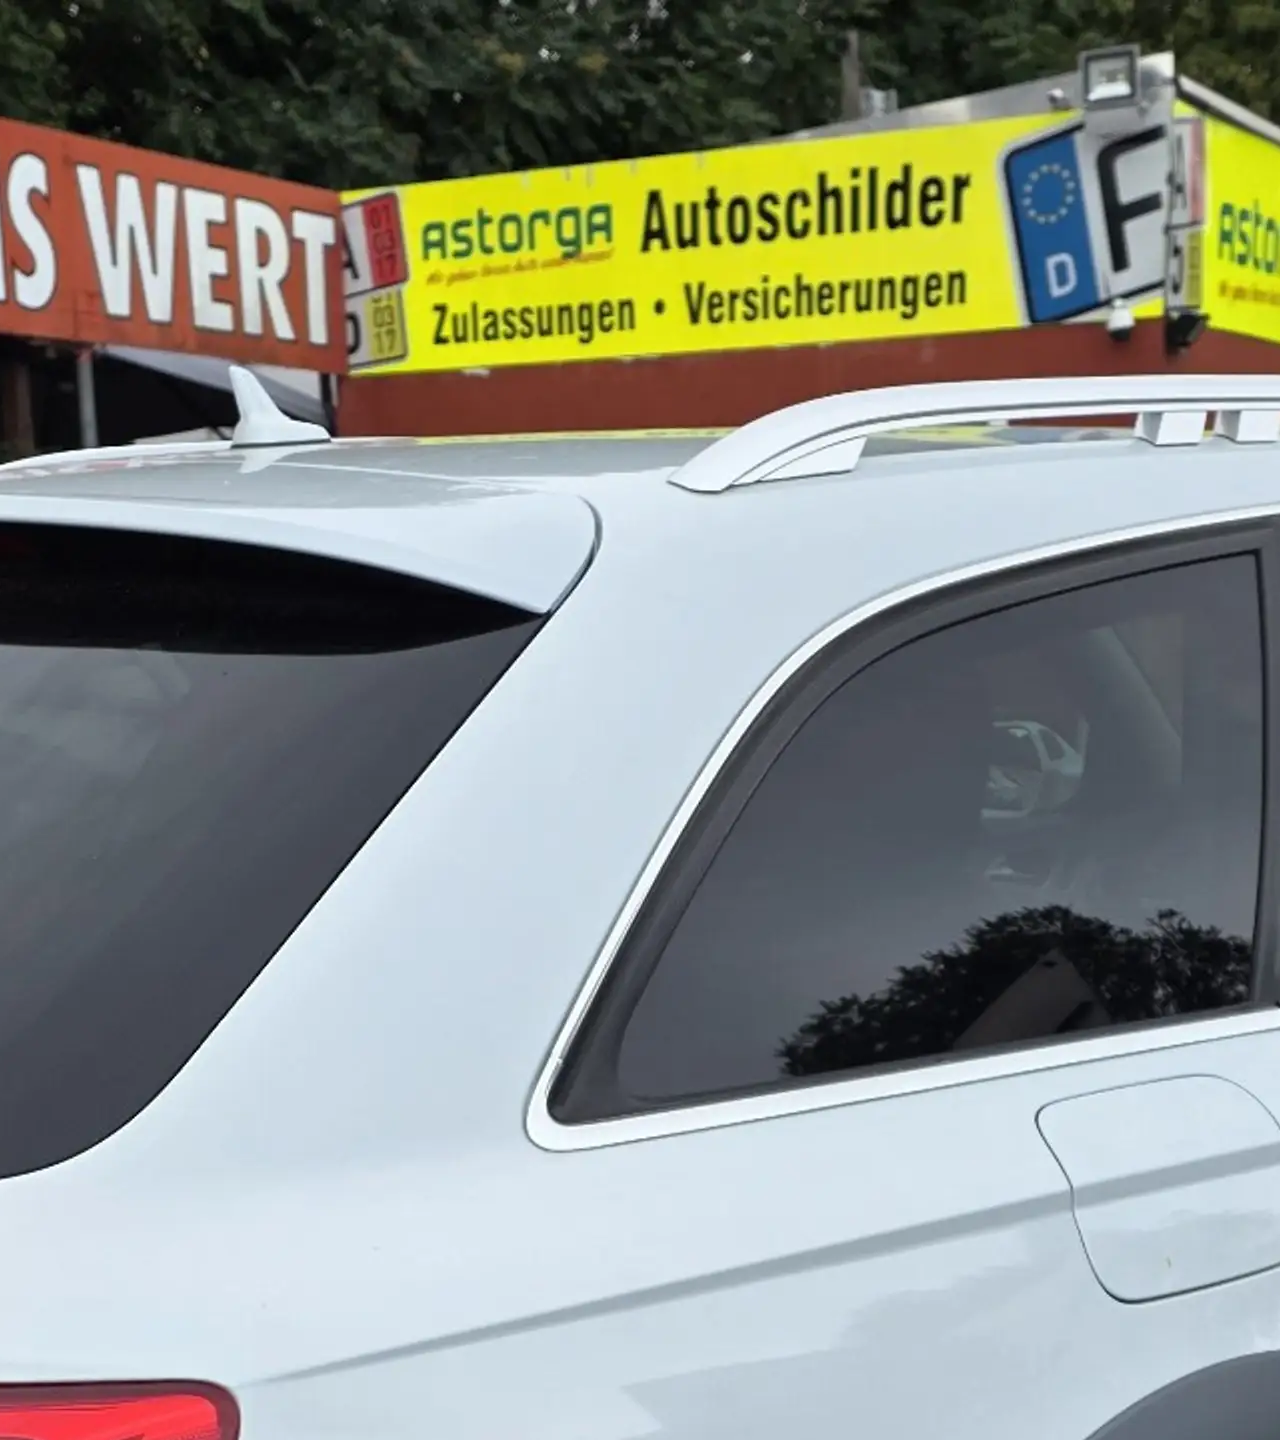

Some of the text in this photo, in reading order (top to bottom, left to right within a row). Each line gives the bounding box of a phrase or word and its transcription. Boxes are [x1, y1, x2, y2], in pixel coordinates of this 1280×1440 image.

[640, 164, 971, 254] Autoschilder
[1098, 125, 1166, 273] F
[76, 164, 337, 346] WERT
[1046, 252, 1078, 298] D
[431, 269, 967, 346] Zulassungen Versicherungen
